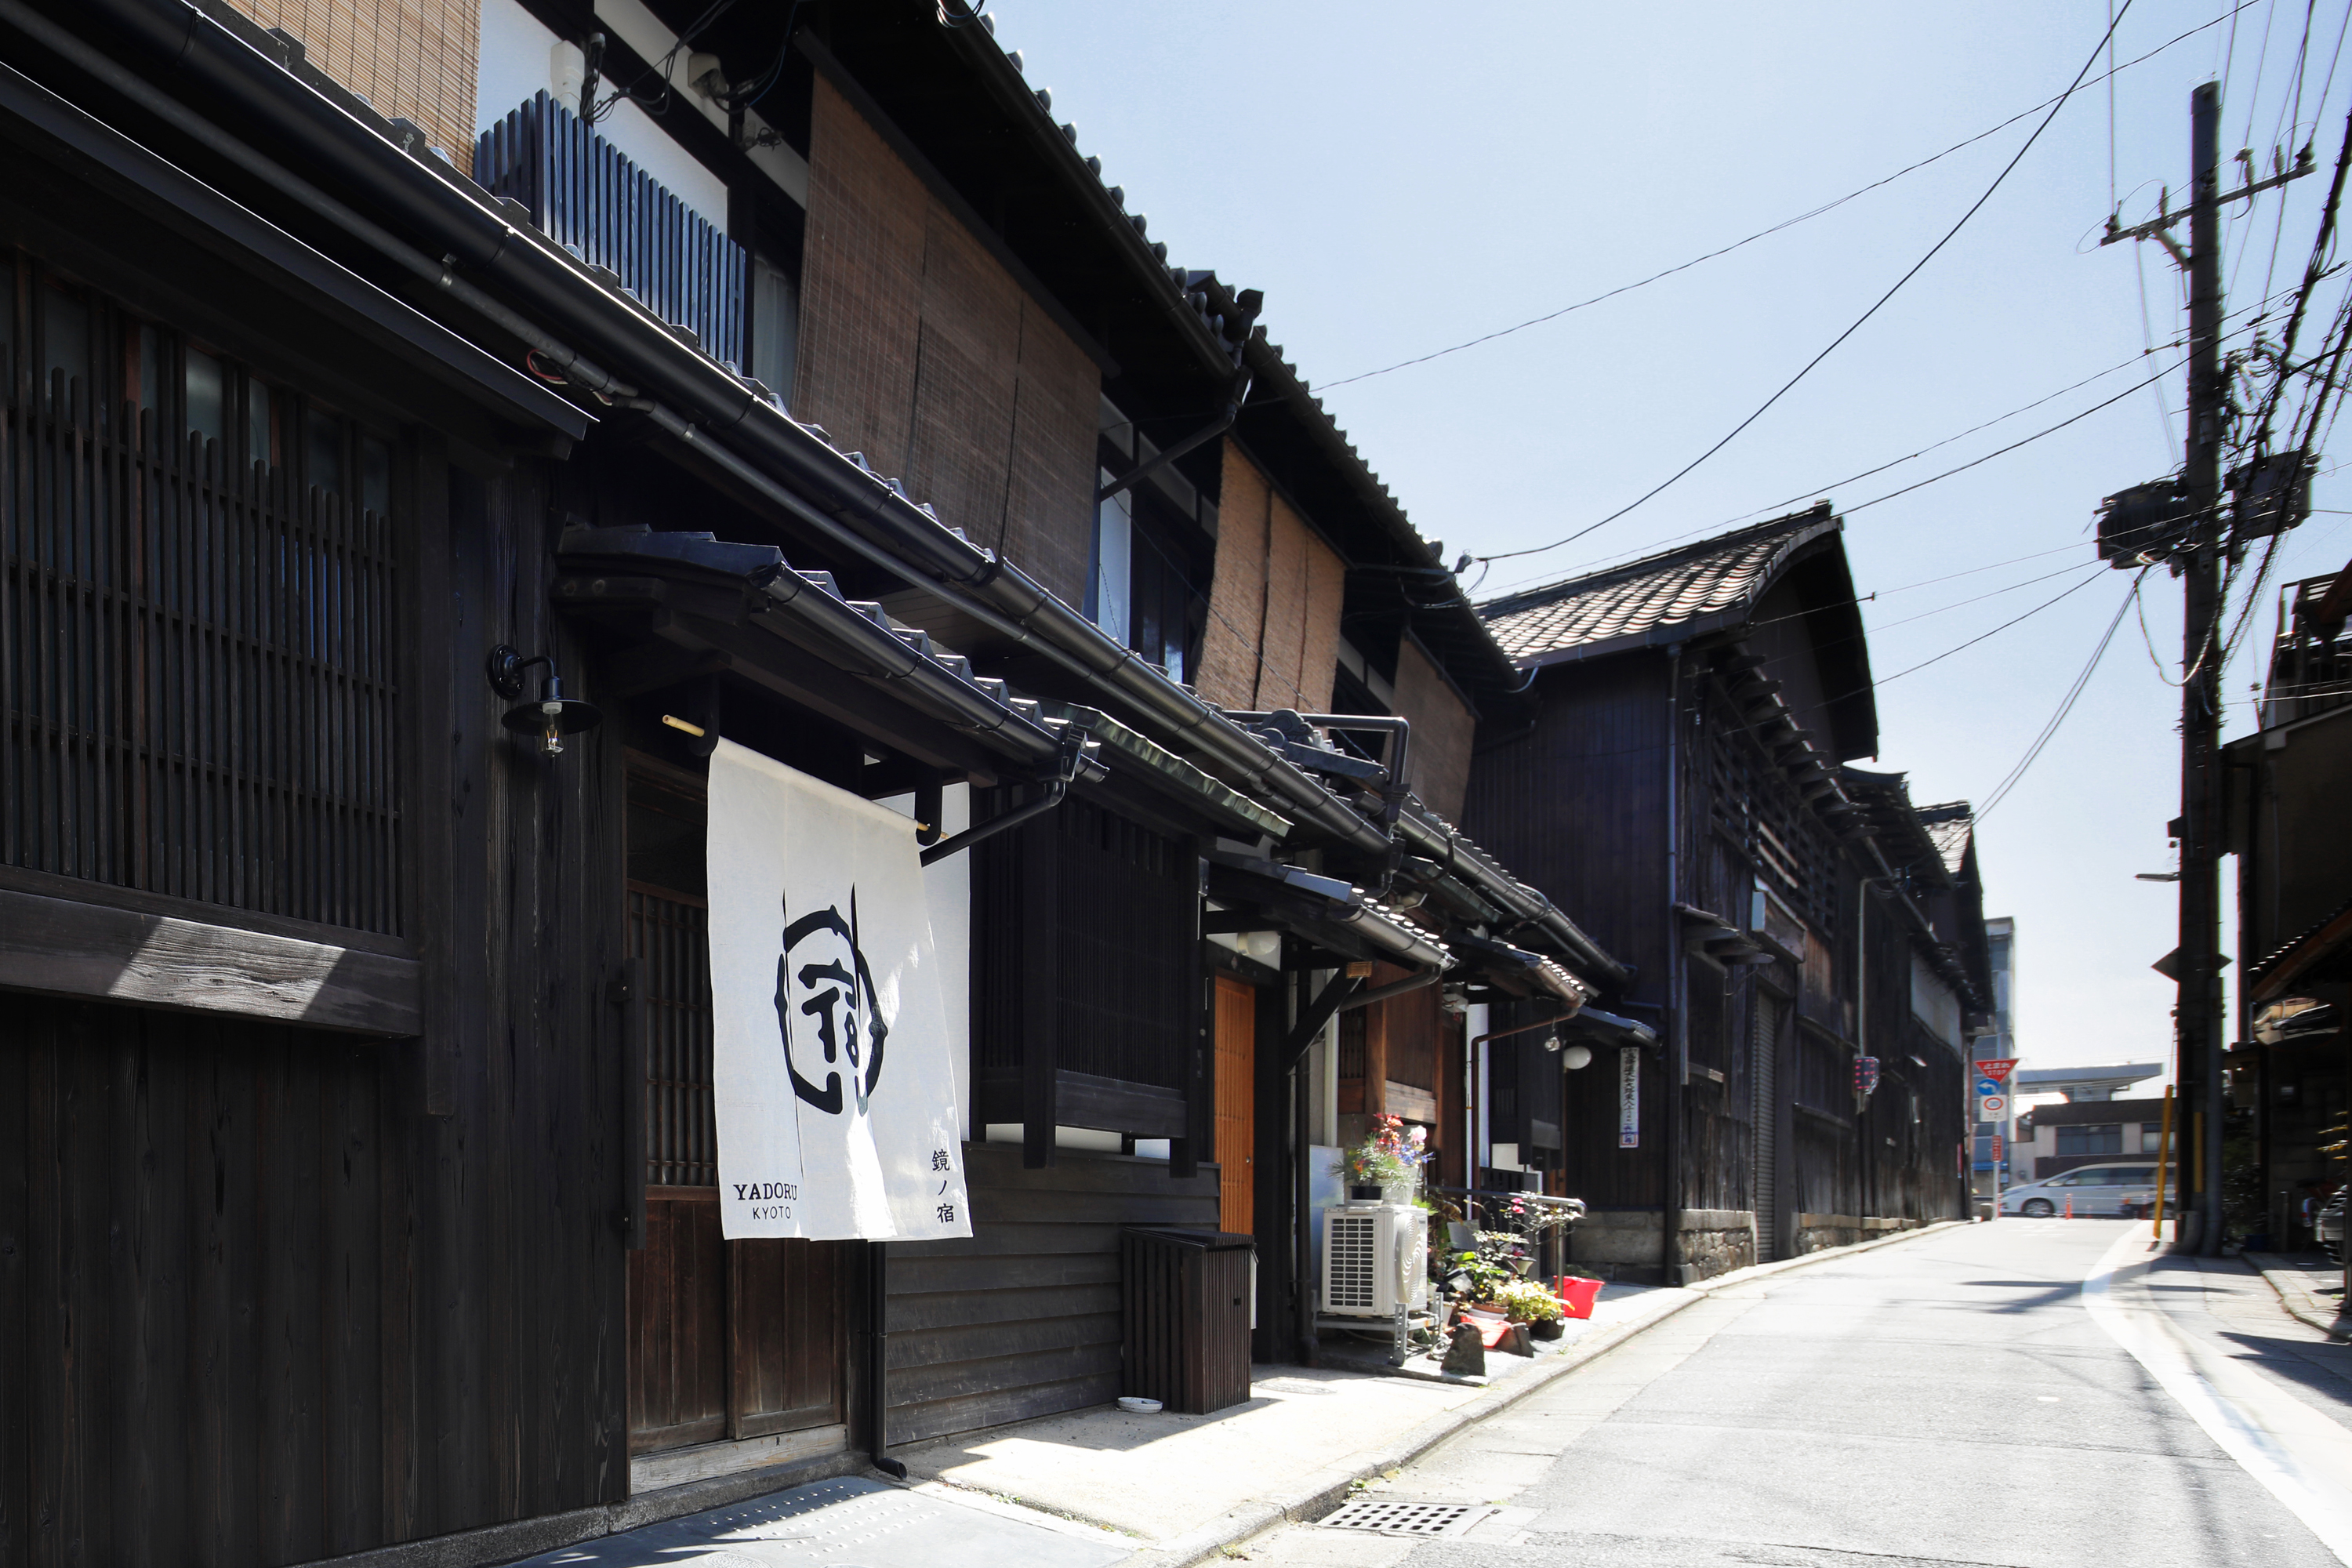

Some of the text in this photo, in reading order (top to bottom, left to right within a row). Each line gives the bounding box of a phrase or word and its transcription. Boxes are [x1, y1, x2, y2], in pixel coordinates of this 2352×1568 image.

[732, 1181, 797, 1200] YADORU
[931, 1149, 954, 1223] 鏡ノ宿
[753, 1206, 791, 1220] KYOTO
